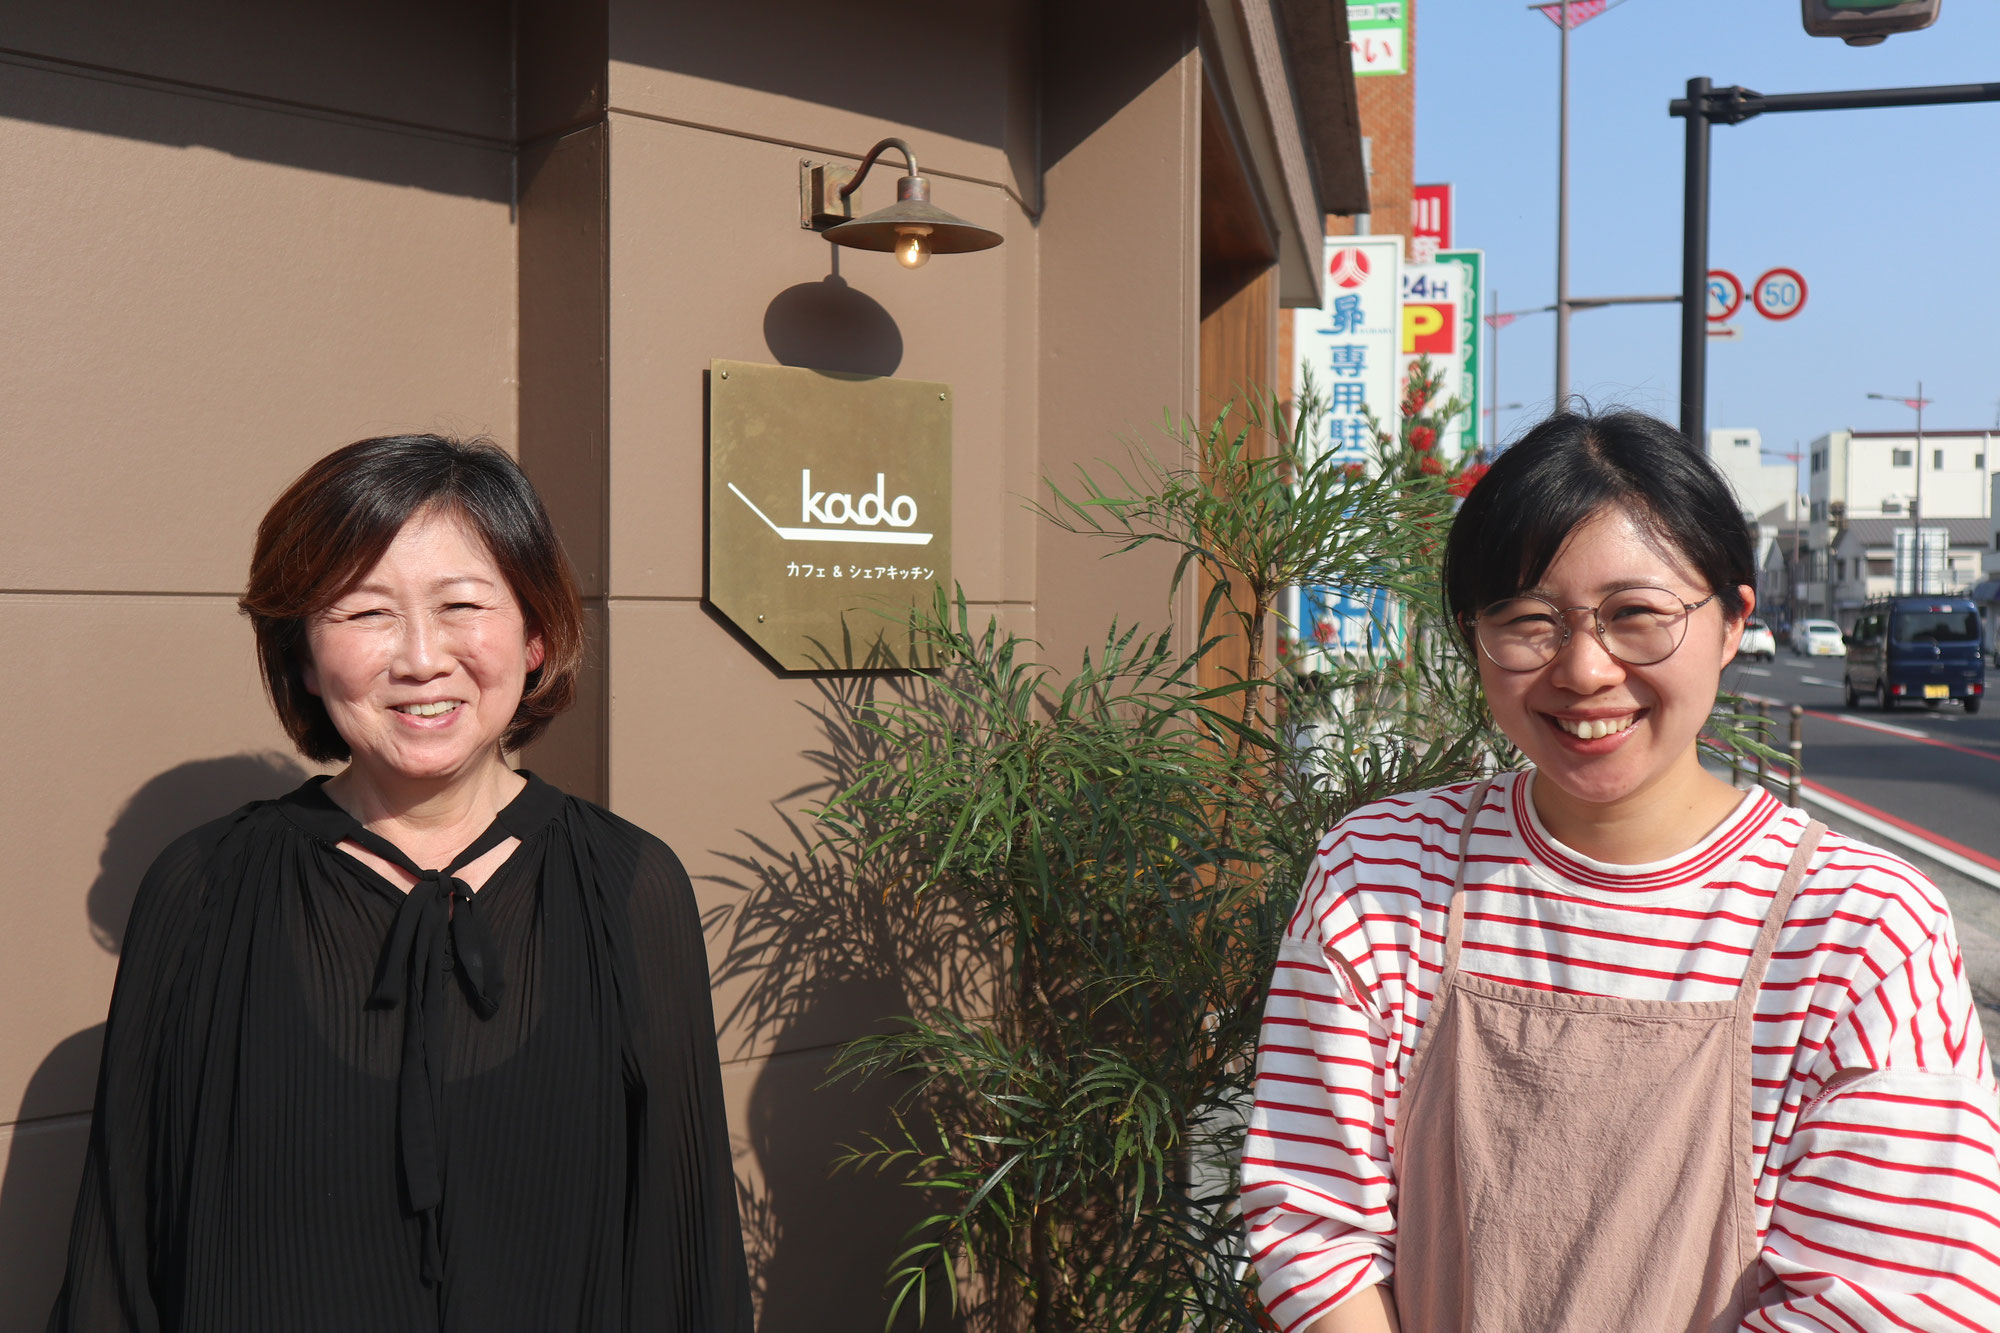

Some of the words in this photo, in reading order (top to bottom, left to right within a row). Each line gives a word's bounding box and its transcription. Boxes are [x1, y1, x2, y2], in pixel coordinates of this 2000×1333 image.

[1765, 282, 1796, 307] 50
[1403, 305, 1444, 353] P
[802, 469, 918, 527] kado
[786, 561, 826, 578] カフェ
[833, 565, 843, 578] &
[849, 565, 935, 580] シェアキッチン
